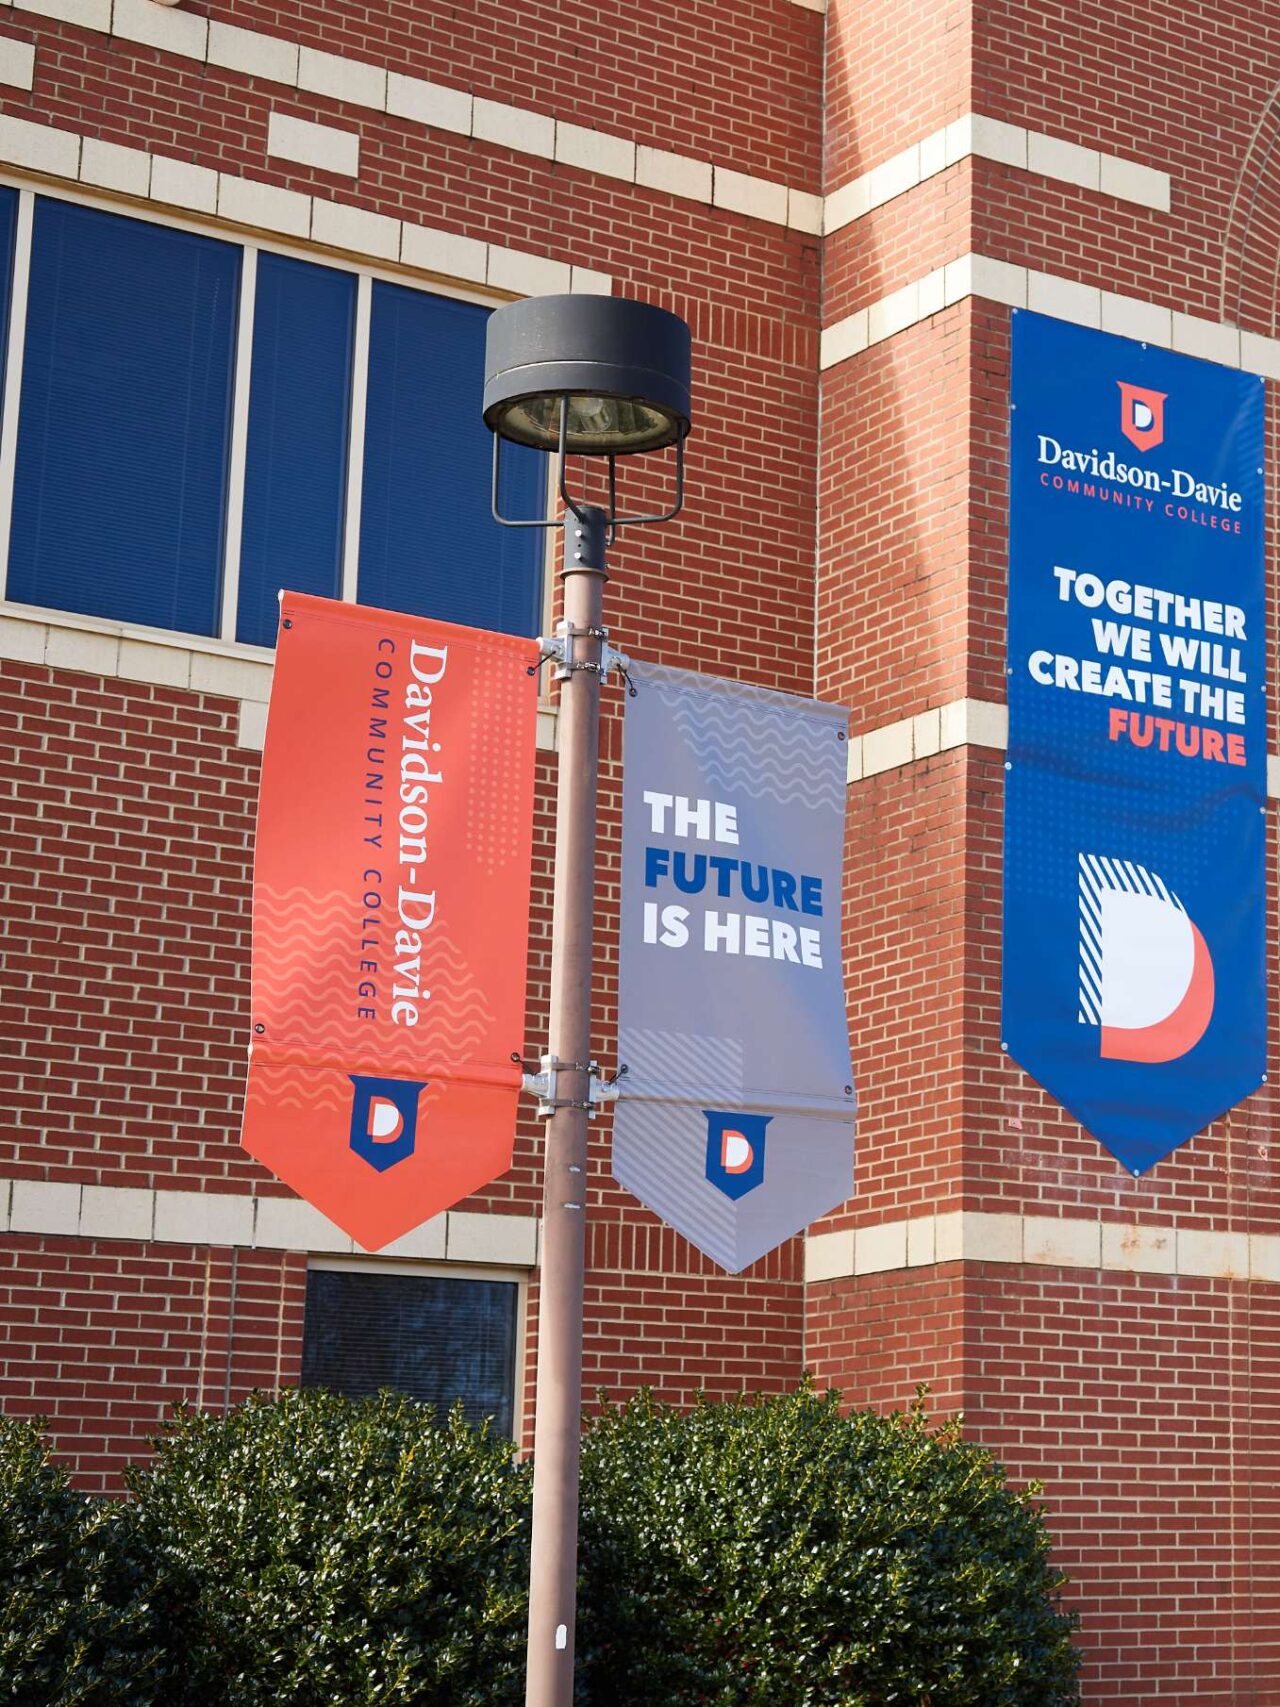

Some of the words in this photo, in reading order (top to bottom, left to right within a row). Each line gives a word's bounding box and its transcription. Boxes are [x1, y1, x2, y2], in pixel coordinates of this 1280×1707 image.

[1037, 435, 1242, 511] Davidson-Davie
[1040, 472, 1154, 512] COMMUNITY
[1165, 503, 1241, 534] COLLEGE
[1054, 566, 1247, 640] TOGETHER
[1091, 618, 1152, 662] WE
[1159, 634, 1247, 683] WILL
[1028, 650, 1172, 708] CREATE
[1179, 679, 1246, 725] THE
[363, 638, 395, 849] COMMUNITY
[1109, 707, 1247, 766] FUTURE
[391, 639, 448, 1027] Davidson-Davie
[643, 790, 740, 845] THE
[644, 847, 823, 917] FUTURE
[357, 869, 382, 1020] COLLEGE
[643, 902, 690, 949] IS
[704, 910, 823, 969] HERE
